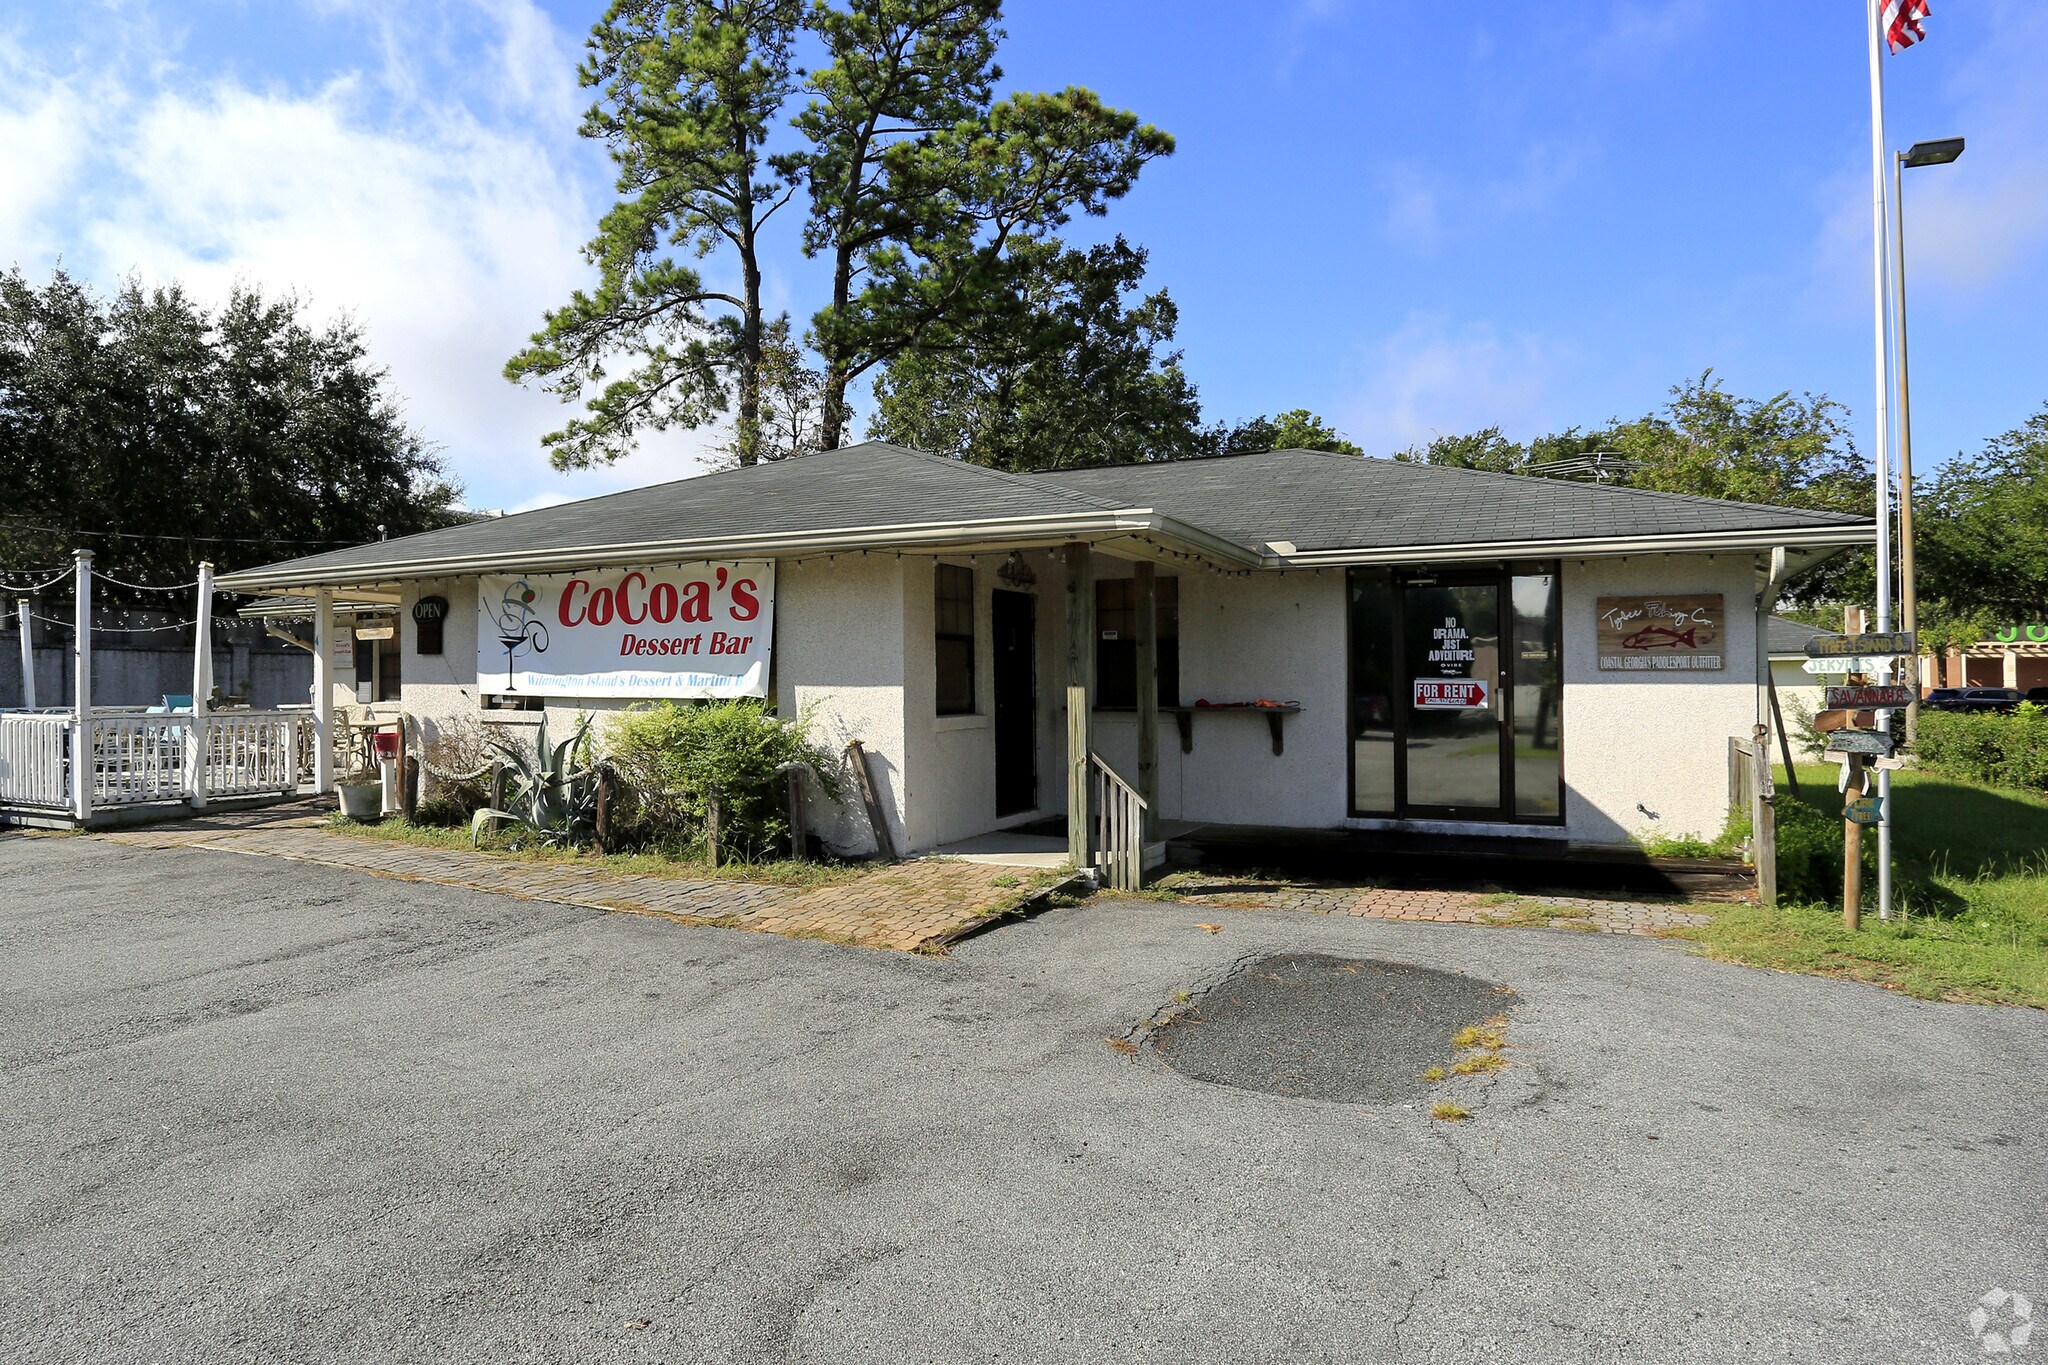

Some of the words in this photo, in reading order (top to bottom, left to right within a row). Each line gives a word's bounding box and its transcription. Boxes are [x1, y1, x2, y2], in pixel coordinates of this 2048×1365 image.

[558, 567, 760, 627] CoCoa's
[415, 603, 441, 618] OPEN
[1445, 617, 1457, 628] NO
[1601, 607, 1642, 630] Tybee
[1433, 628, 1469, 639] DRAMA.
[620, 633, 702, 656] Dessert
[709, 631, 753, 655] Bar
[1442, 639, 1460, 650] JUST
[1600, 657, 1623, 669] COASTAL
[527, 674, 584, 688] Wilmington
[586, 674, 626, 687] Island's
[628, 674, 673, 687] Dessert
[675, 675, 684, 687] &
[687, 674, 732, 687] Martini
[1417, 684, 1438, 698] FOR
[1444, 684, 1475, 698] RENT
[1831, 687, 1894, 706] SAVANNAH
